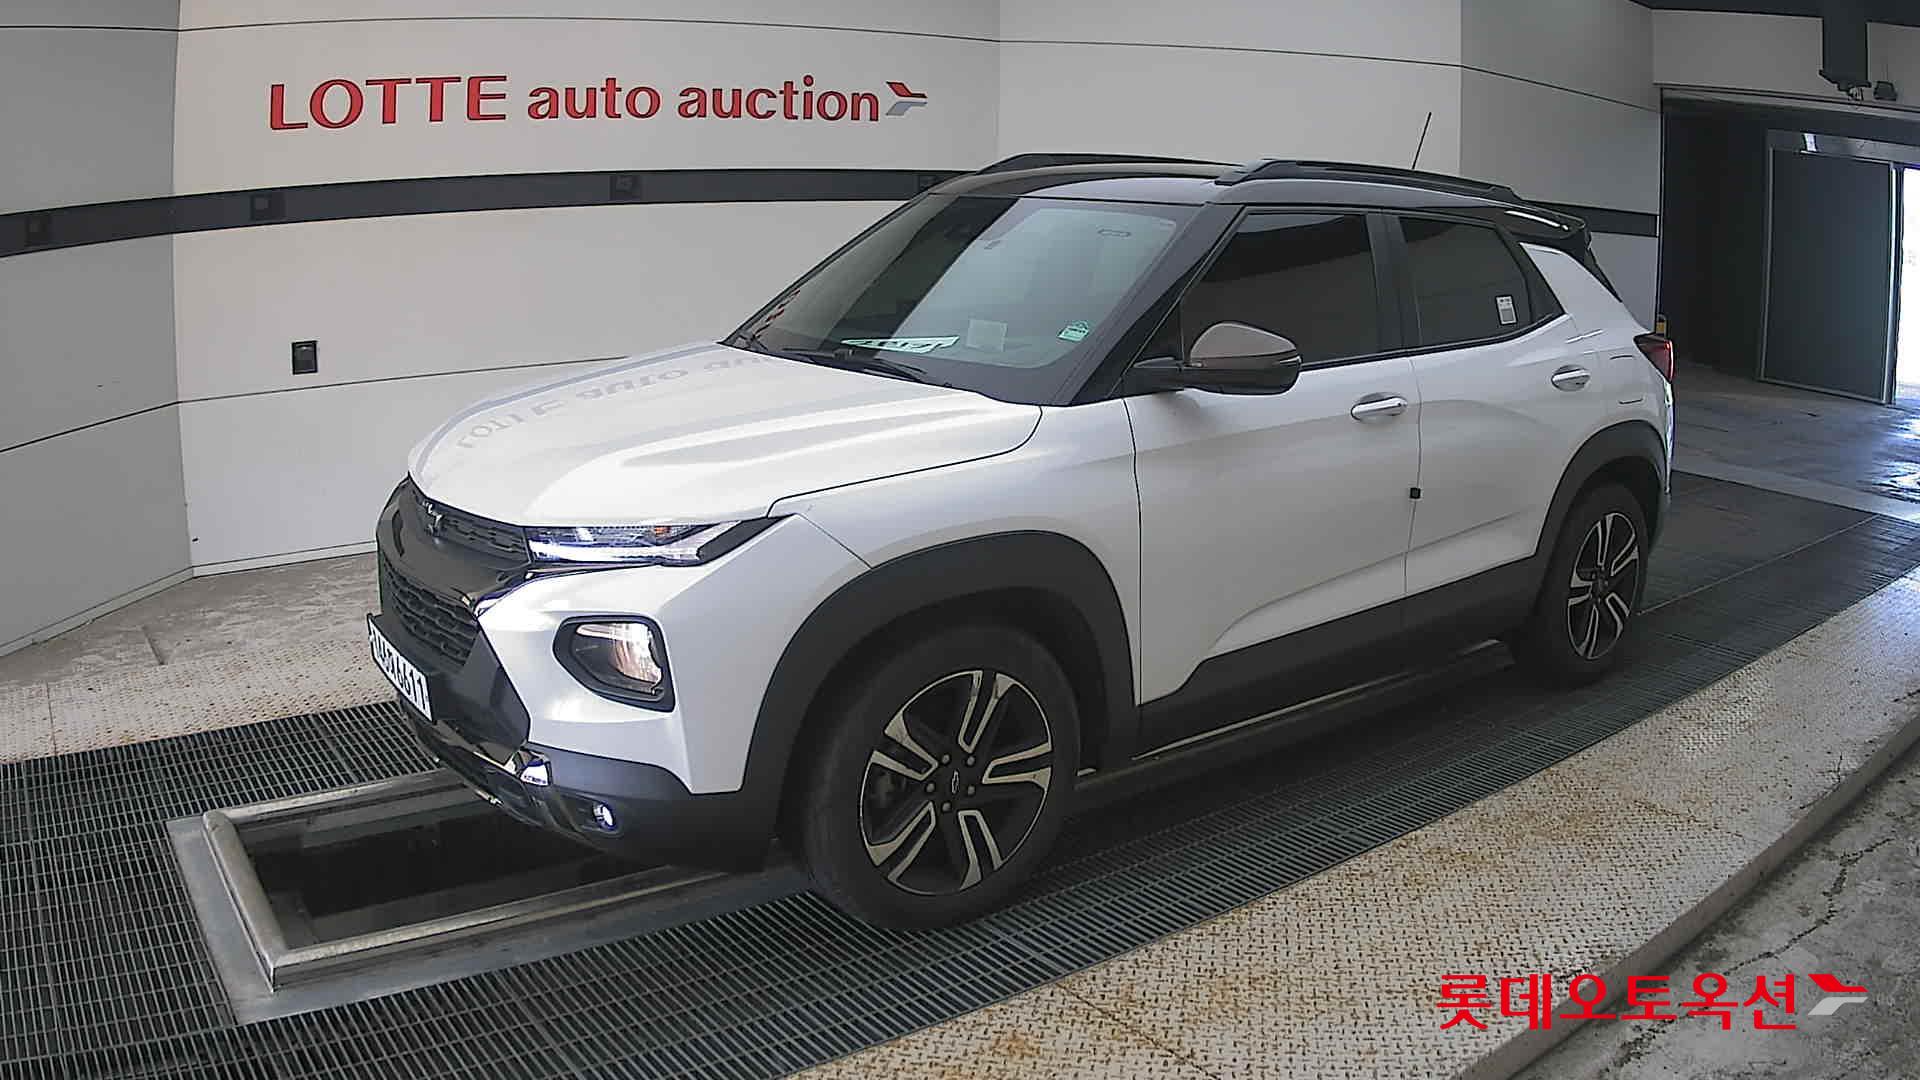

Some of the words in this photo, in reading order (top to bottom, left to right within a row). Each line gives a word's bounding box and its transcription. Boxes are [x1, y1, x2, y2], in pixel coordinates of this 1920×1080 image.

[270, 75, 507, 130] LOTTE
[527, 77, 662, 121] auto
[677, 75, 879, 121] auction
